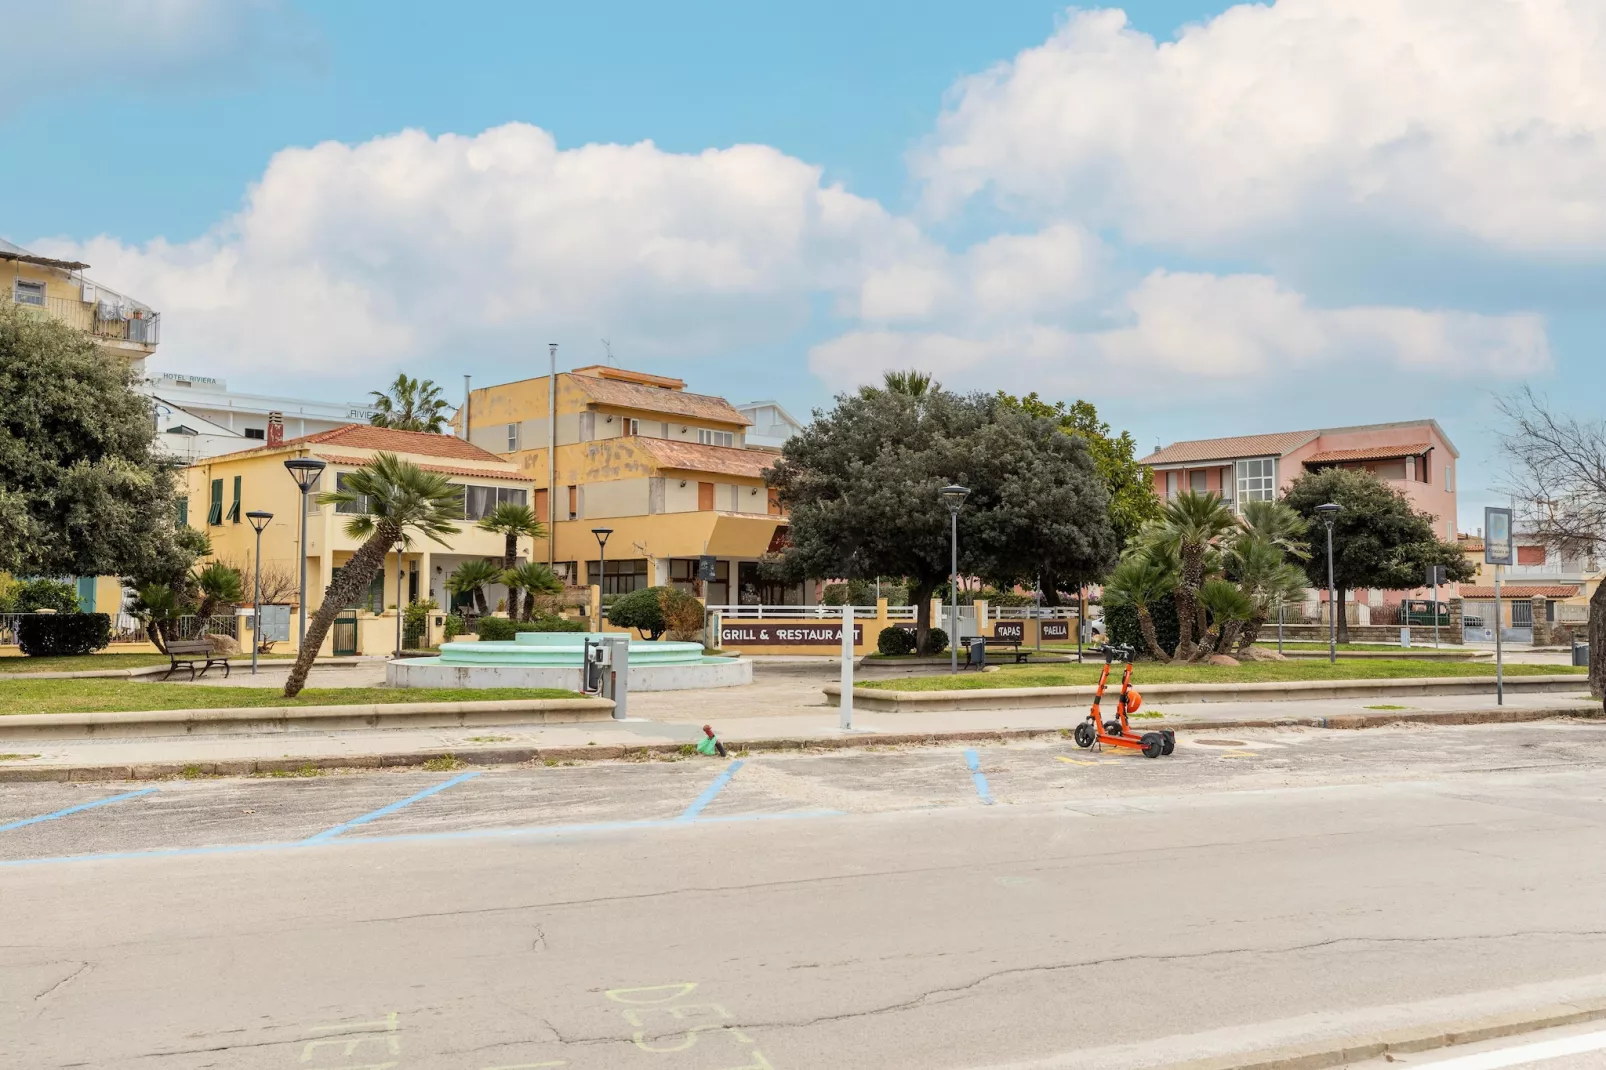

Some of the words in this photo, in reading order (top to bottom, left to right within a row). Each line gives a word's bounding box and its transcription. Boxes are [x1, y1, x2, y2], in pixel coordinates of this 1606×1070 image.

[163, 373, 185, 381] HOTEL
[189, 376, 217, 384] RIVIERA
[722, 629, 757, 640] GRILL
[759, 629, 770, 640] &
[776, 629, 860, 640] RESTAURAT
[997, 626, 1021, 636] TAPAS
[1043, 626, 1067, 635] PAELLA
